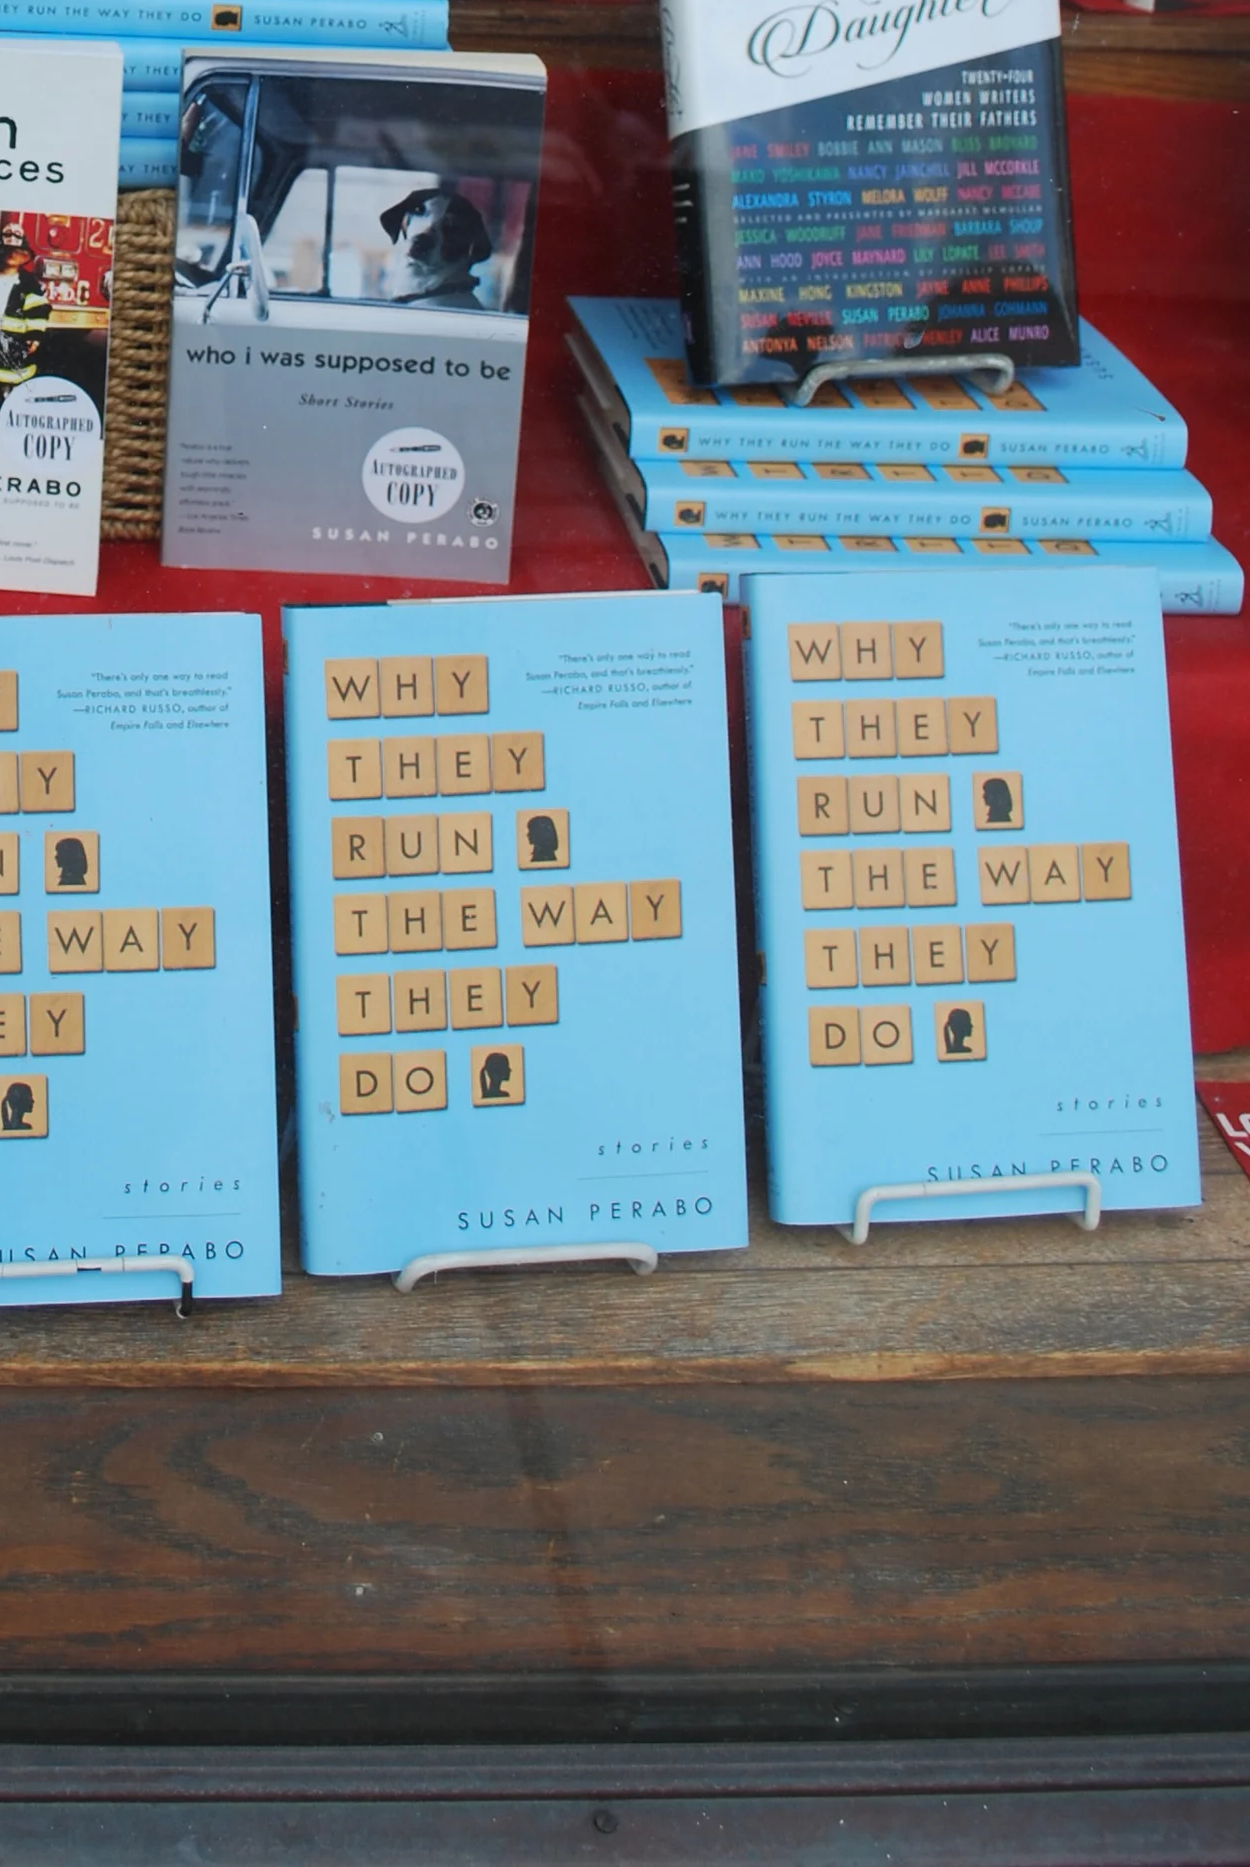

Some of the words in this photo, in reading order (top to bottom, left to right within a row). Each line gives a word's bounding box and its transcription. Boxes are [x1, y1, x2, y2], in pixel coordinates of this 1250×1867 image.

[922, 91, 971, 106] WOMEN
[979, 90, 1035, 105] WRITERS
[847, 113, 923, 131] REMEMBER
[931, 112, 972, 128] THEIR
[980, 110, 1037, 127] FATHERS
[187, 346, 236, 365] who
[245, 347, 252, 365] i
[260, 351, 304, 367] was
[315, 353, 435, 375] supposed
[446, 361, 469, 377] to
[480, 361, 511, 380] be
[299, 393, 338, 407] Short
[345, 397, 394, 411] Stories
[6, 410, 94, 432] AUTOGRAPHED
[23, 434, 75, 461] COPY
[370, 459, 457, 480] AUTOGRAPHED
[387, 483, 437, 506] COPY
[312, 527, 389, 542] SUSAN
[407, 532, 498, 550] PERABO
[791, 632, 930, 670] WHY
[805, 706, 985, 748] THEY
[810, 784, 941, 824] RUN
[814, 858, 941, 897] THE
[982, 851, 1118, 891] WAY
[818, 934, 1003, 977] THEY
[821, 1016, 904, 1054] DO
